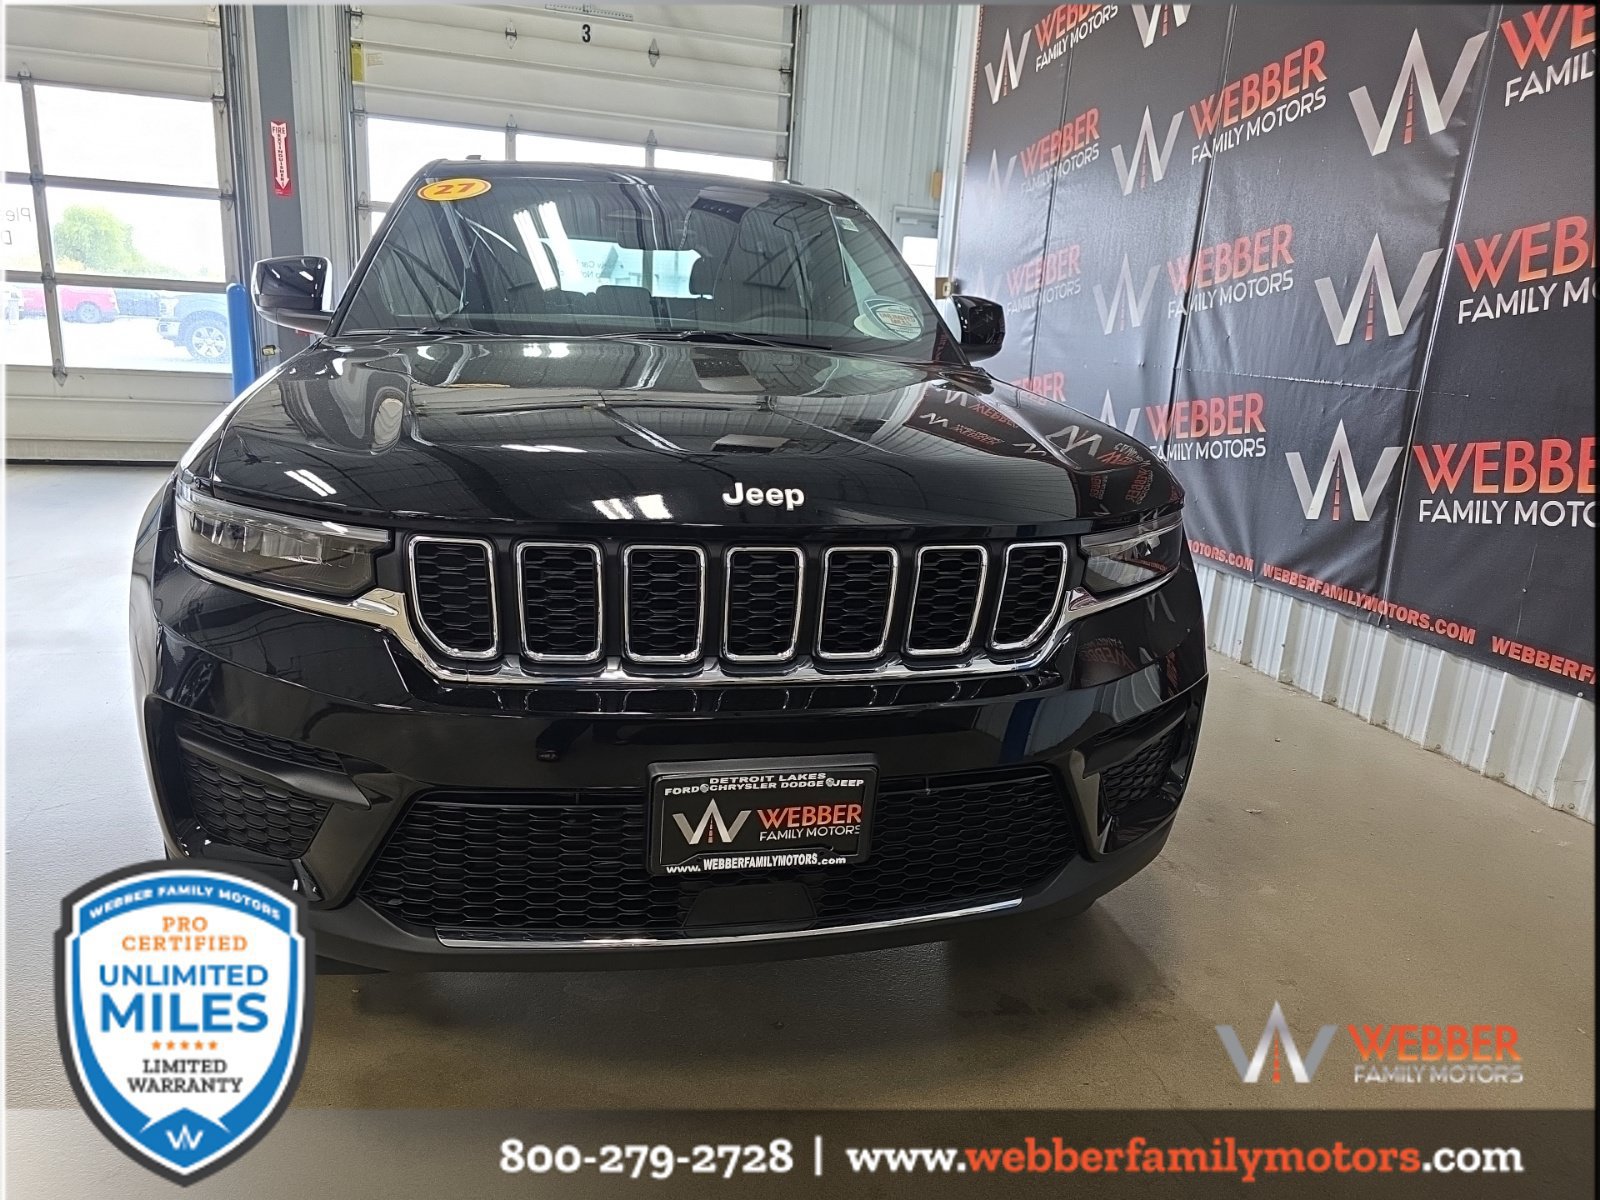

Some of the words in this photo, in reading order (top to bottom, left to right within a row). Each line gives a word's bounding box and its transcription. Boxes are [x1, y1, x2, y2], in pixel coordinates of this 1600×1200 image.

[582, 24, 591, 43] 3
[1034, 4, 1102, 52] WEB
[1035, 34, 1069, 72] FAMILY
[1070, 4, 1118, 48] MOTORS
[1189, 40, 1328, 140] WEBBER
[1504, 48, 1596, 107] FAMIL
[272, 126, 286, 134] FIRE
[1020, 106, 1099, 178] WEBBER
[1191, 122, 1244, 165] FAMILY
[1247, 86, 1327, 141] MOTORS
[1054, 142, 1100, 180] MOTORS
[433, 182, 476, 196] 27
[1167, 223, 1294, 296] WEBBER
[1455, 215, 1596, 293] WEB
[1168, 289, 1218, 319] FAMILY
[1220, 269, 1294, 307] MOTORS
[1458, 282, 1558, 324] FAMILY
[1563, 276, 1596, 307] M
[1145, 392, 1267, 442] WEBBER
[1195, 437, 1267, 460] MOTORS
[722, 482, 805, 511] Jeep
[1418, 499, 1509, 525] FAMILY
[1263, 563, 1476, 646] WEBBERFAMILYMOTORS.COM
[664, 786, 699, 796] FORD
[709, 781, 777, 791] CHRYSLER
[780, 780, 824, 789] DODGE
[832, 779, 865, 787] JEEP
[709, 775, 775, 784] DETROIT
[778, 772, 827, 782] LAKES
[757, 803, 862, 829] WEBBER
[759, 828, 804, 842] FAMILY
[805, 824, 861, 838] MOTORS
